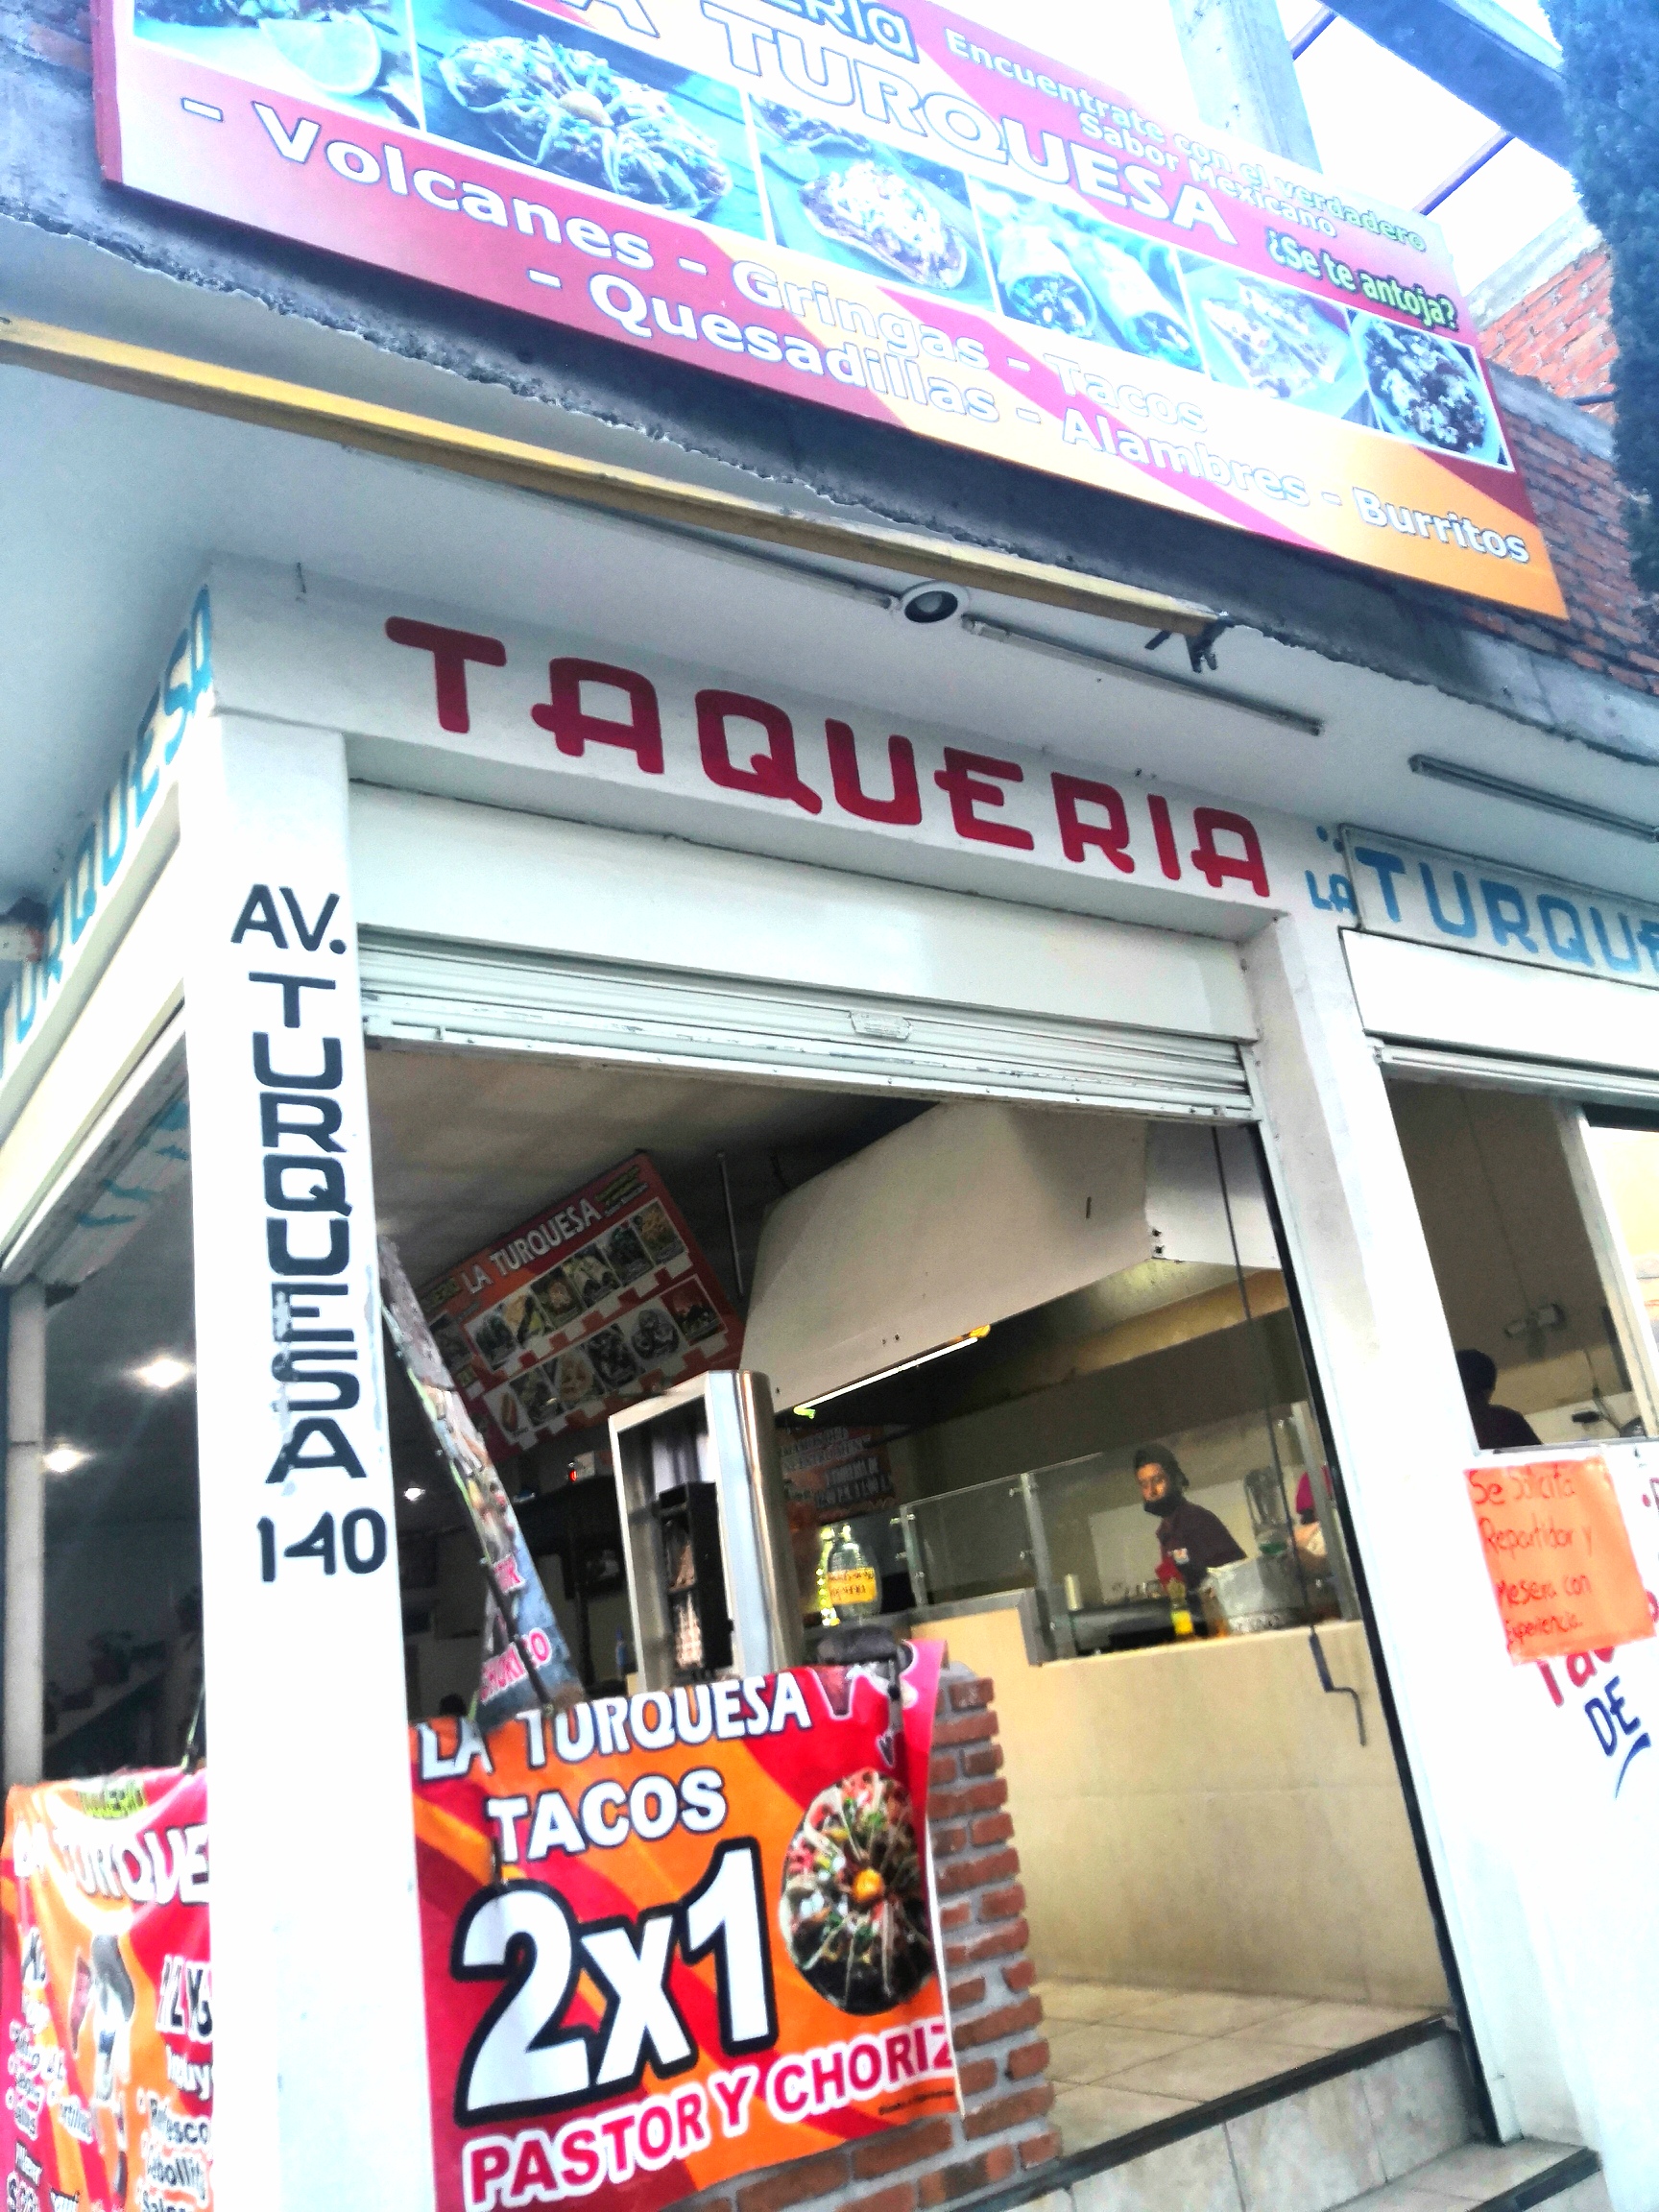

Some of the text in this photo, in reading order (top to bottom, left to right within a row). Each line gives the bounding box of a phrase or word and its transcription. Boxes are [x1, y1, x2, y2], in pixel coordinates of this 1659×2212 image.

[701, 0, 1239, 246] TURQUESA
[945, 27, 1428, 252] Encuentrate con el verdadero
[1077, 109, 1337, 238] Sabor Mexicano
[252, 101, 655, 272] Volcanes
[732, 258, 990, 370] Gringas
[1042, 352, 1209, 433] Tacos
[1264, 226, 1458, 331] ¿Se te antoja?
[588, 273, 999, 422] Quesadillas
[1063, 408, 1311, 508] Alambres
[1352, 486, 1531, 565] Burritos
[385, 615, 1271, 898] TAQUERIA
[230, 882, 348, 956] AV.
[1305, 869, 1357, 915] LA
[247, 971, 368, 1485] TURQUESA
[460, 1266, 493, 1295] LA
[490, 1197, 606, 1277] TURQUESA
[1468, 1469, 1506, 1505] Se
[256, 1505, 388, 1583] 140
[415, 1671, 814, 1782] LA TURQUESA
[1584, 1674, 1642, 1758] DE
[487, 1766, 729, 1865] TACOS
[466, 2084, 706, 2209] PASTOR
[712, 2064, 759, 2137] Y
